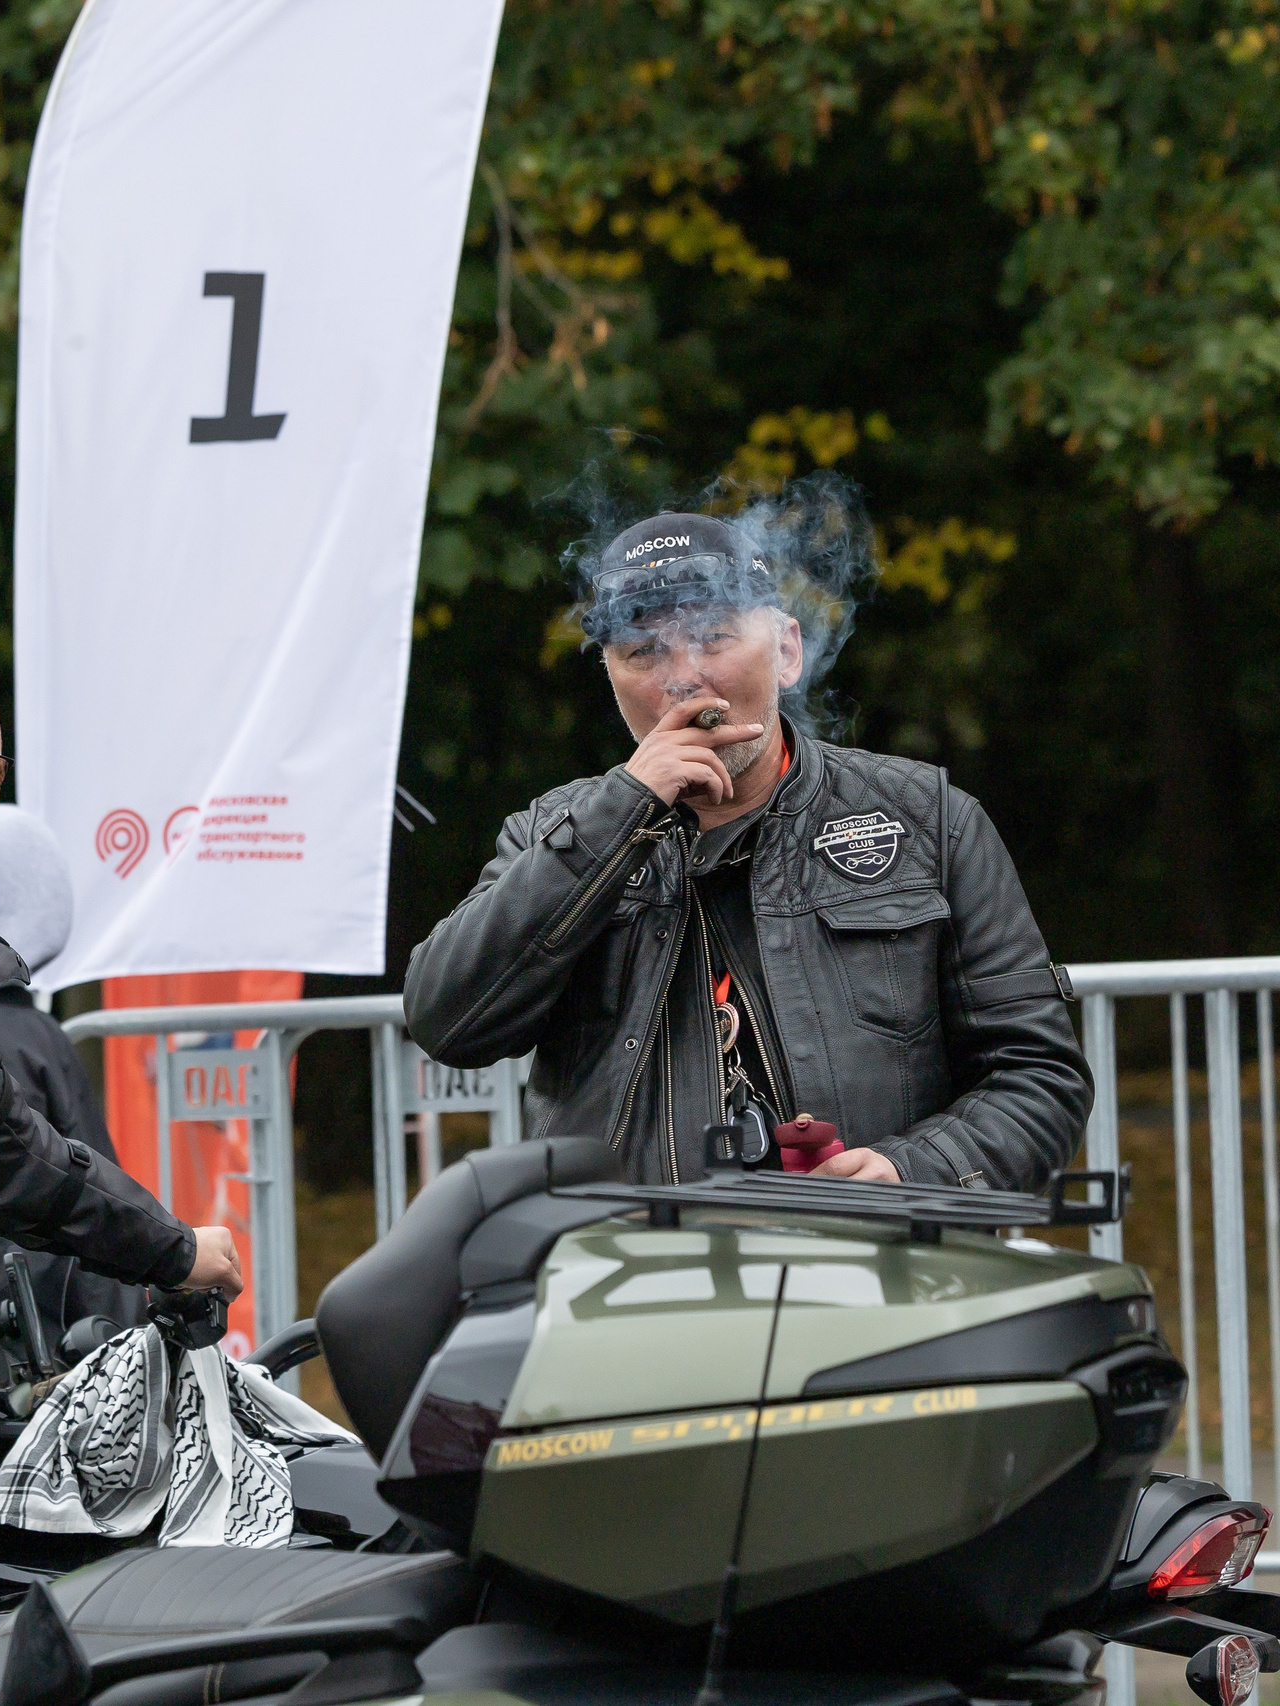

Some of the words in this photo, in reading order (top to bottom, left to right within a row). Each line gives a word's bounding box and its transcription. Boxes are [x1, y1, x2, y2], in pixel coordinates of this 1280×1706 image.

[190, 272, 287, 443] 1
[625, 535, 690, 562] MOSCOW
[832, 816, 878, 832] MOSCOW
[848, 838, 876, 850] CLUB
[497, 1428, 614, 1465] MOSCOW
[912, 1386, 978, 1417] CLUB
